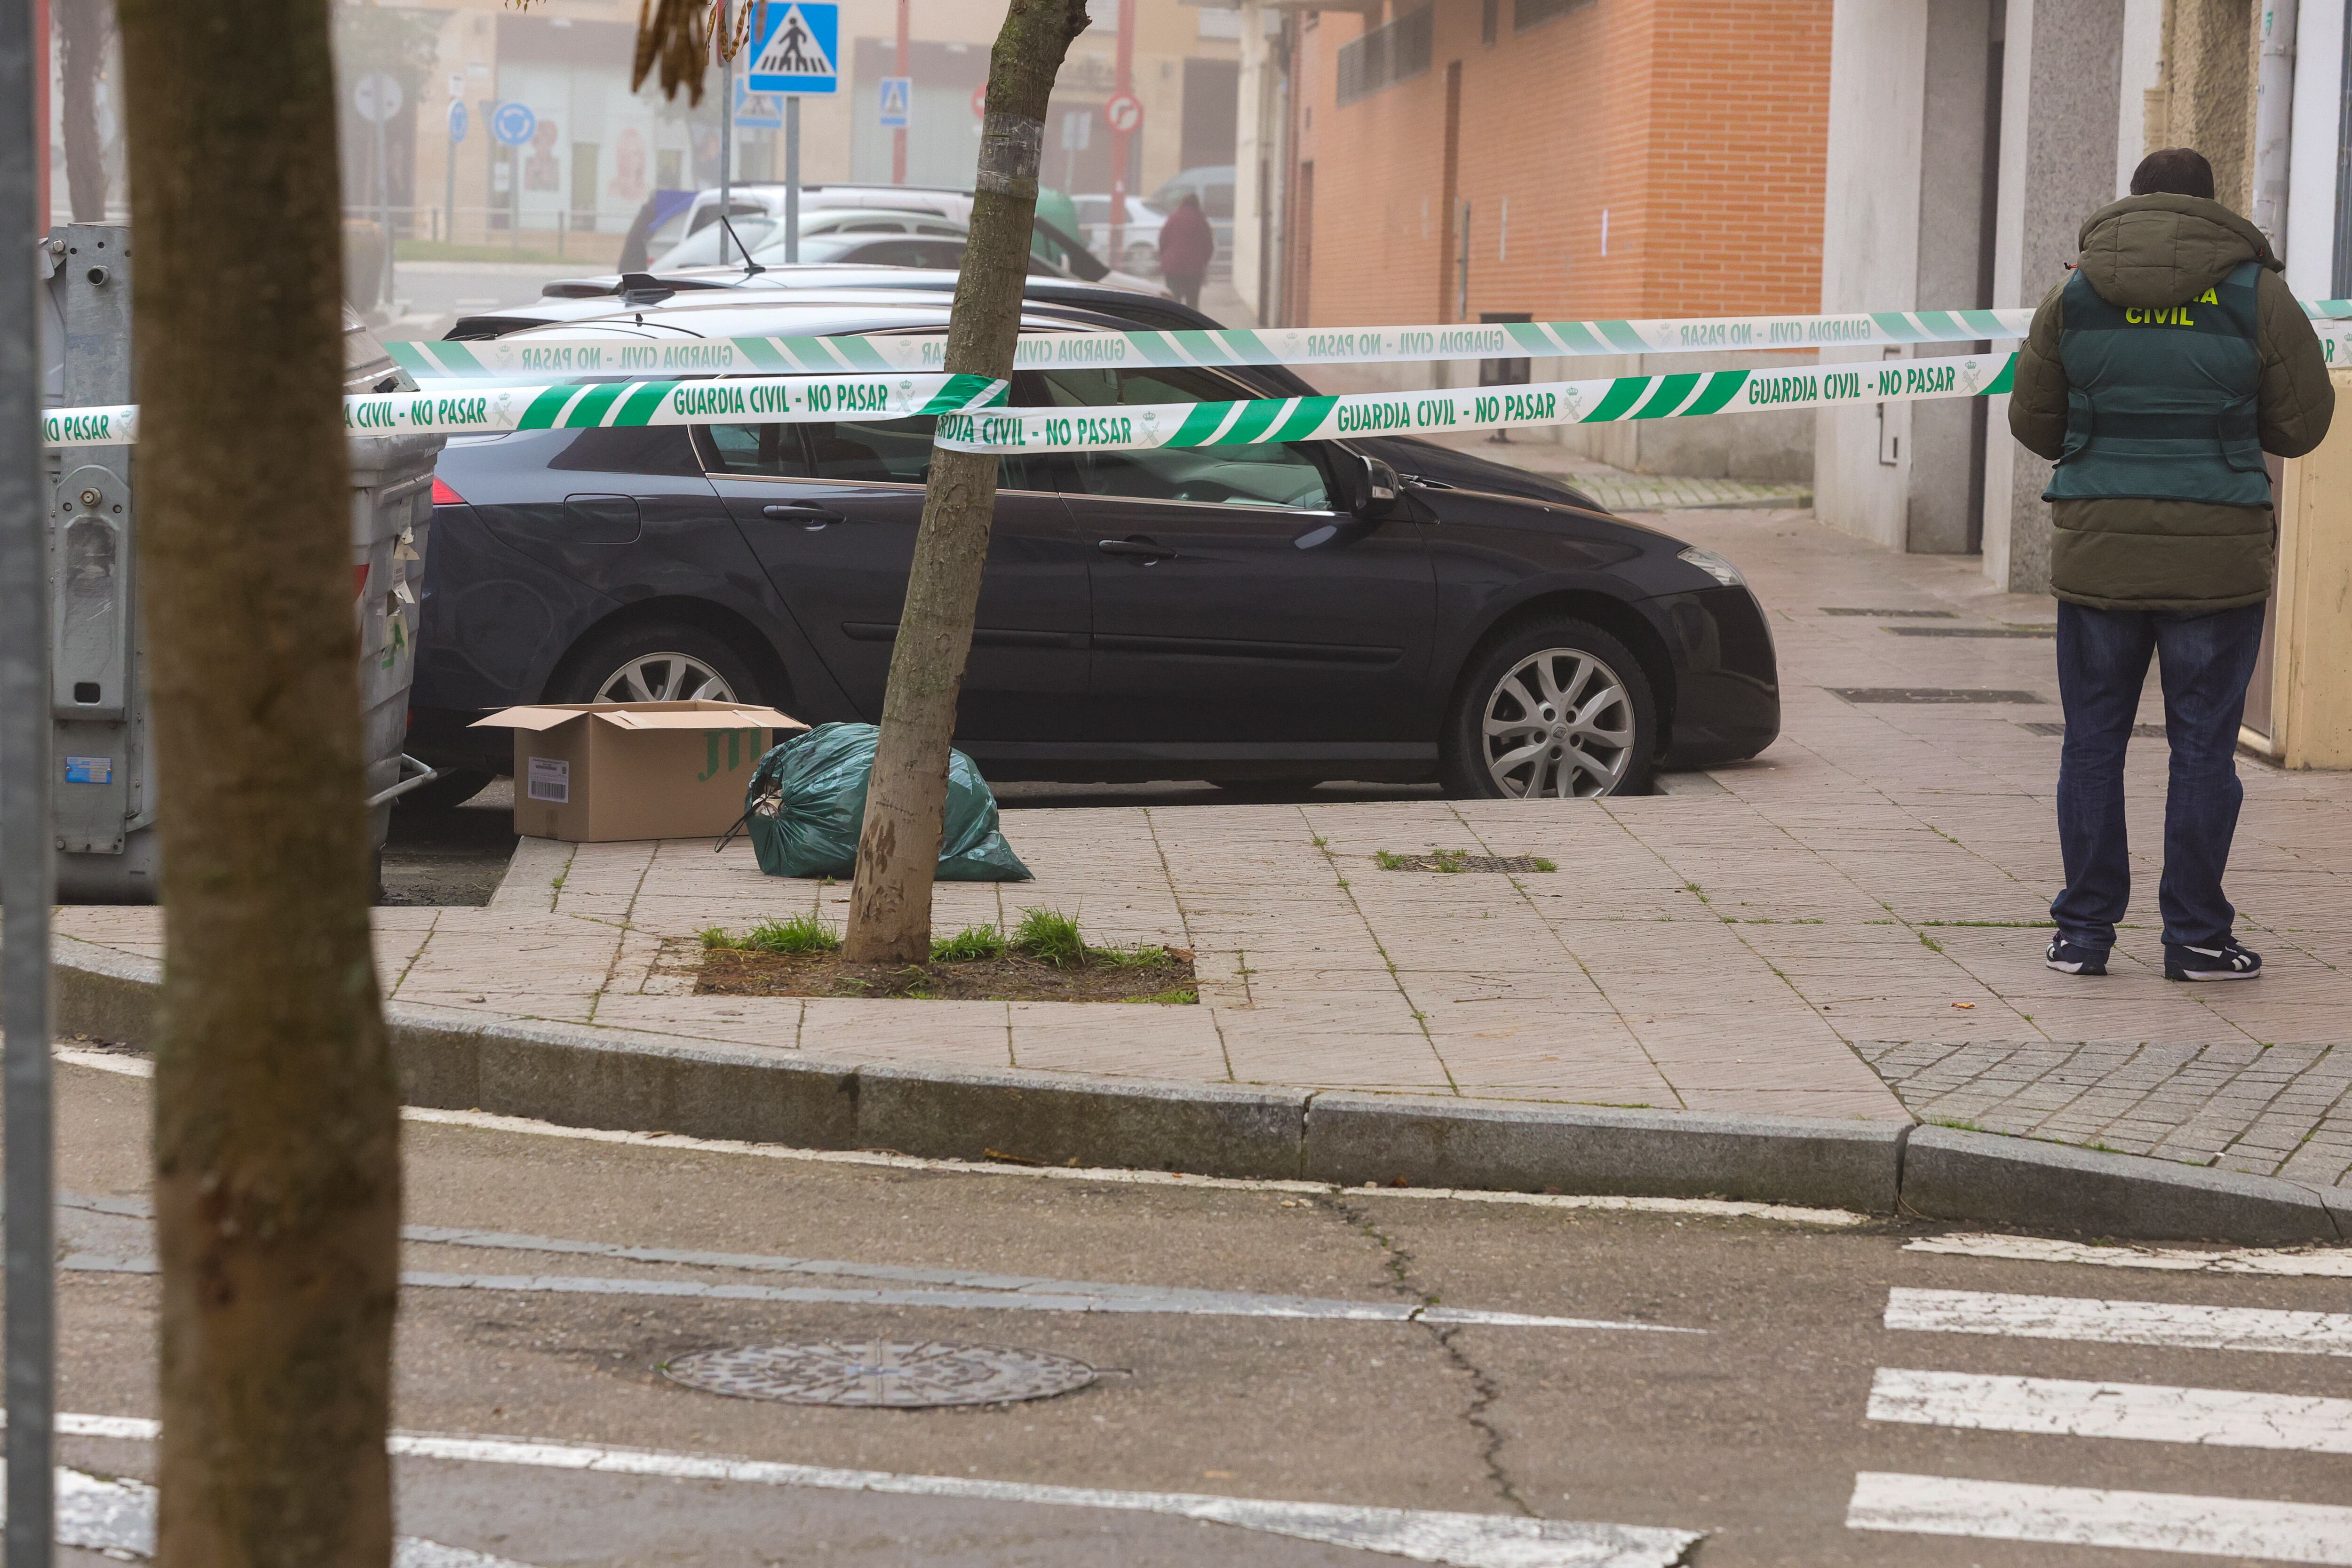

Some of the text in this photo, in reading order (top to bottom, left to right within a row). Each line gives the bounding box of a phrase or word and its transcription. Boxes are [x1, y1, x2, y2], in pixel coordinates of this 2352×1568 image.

[2126, 306, 2194, 326] CIVIL
[673, 385, 746, 415] GUARDIA
[750, 384, 790, 413] CIVIL
[807, 384, 832, 413] NO
[837, 383, 889, 412] PASAR
[1749, 375, 1818, 405] GUARDIA
[1824, 372, 1861, 399] CIVIL
[1878, 369, 1902, 396] NO
[1907, 366, 1955, 394] PASAR
[64, 414, 112, 441] PASAR
[357, 401, 396, 428] CIVIL
[411, 399, 433, 426] NO
[438, 397, 488, 424] PASAR
[1338, 401, 1410, 432] GUARDIA
[1417, 398, 1456, 427] CIVIL
[1475, 396, 1500, 423] NO
[1504, 393, 1556, 422] PASAR
[983, 417, 1026, 446] CIVIL
[1046, 418, 1072, 446] NO
[1077, 416, 1132, 445] PASAR
